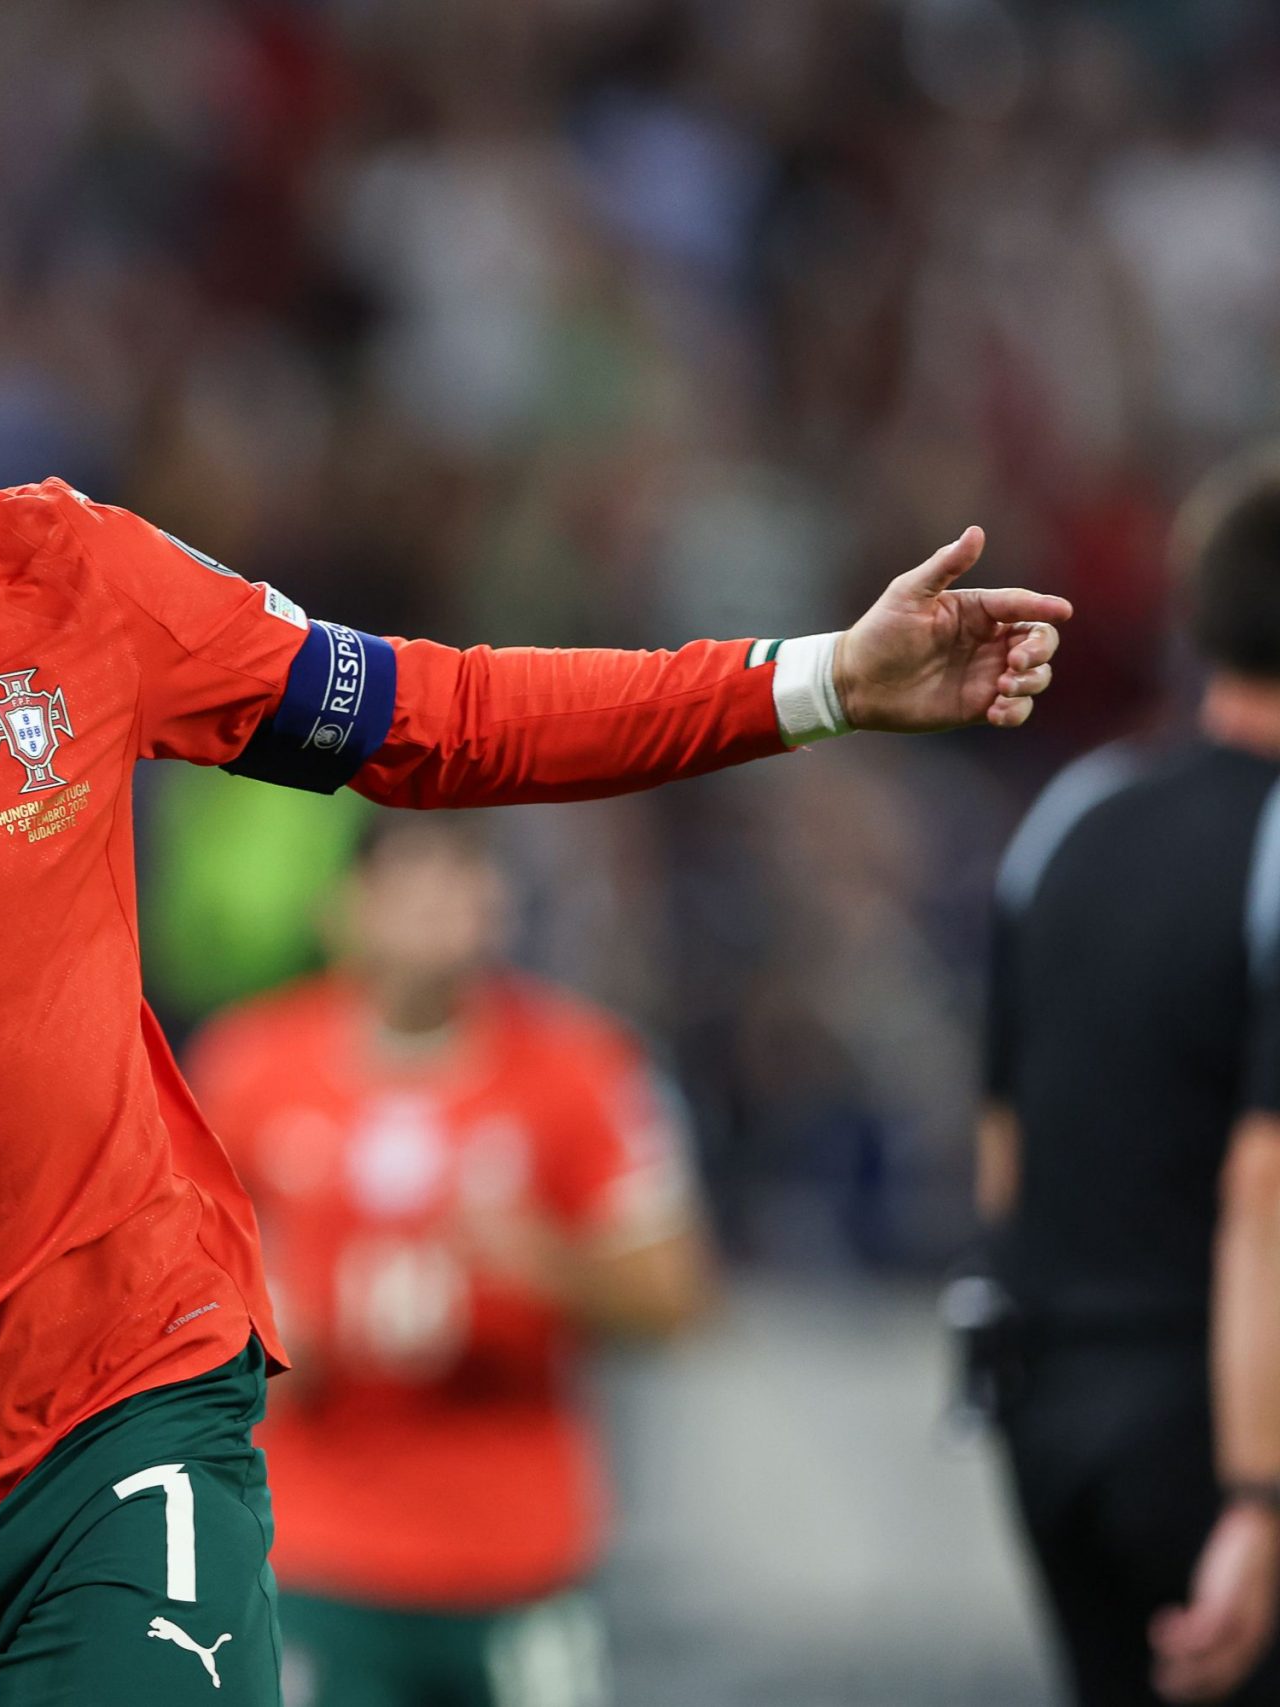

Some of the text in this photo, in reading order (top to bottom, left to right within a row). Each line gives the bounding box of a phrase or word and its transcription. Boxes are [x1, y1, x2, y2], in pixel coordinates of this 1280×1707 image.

[6, 823, 15, 836] 9
[27, 815, 76, 843] BUDAPESTE
[112, 1463, 197, 1602] 7
